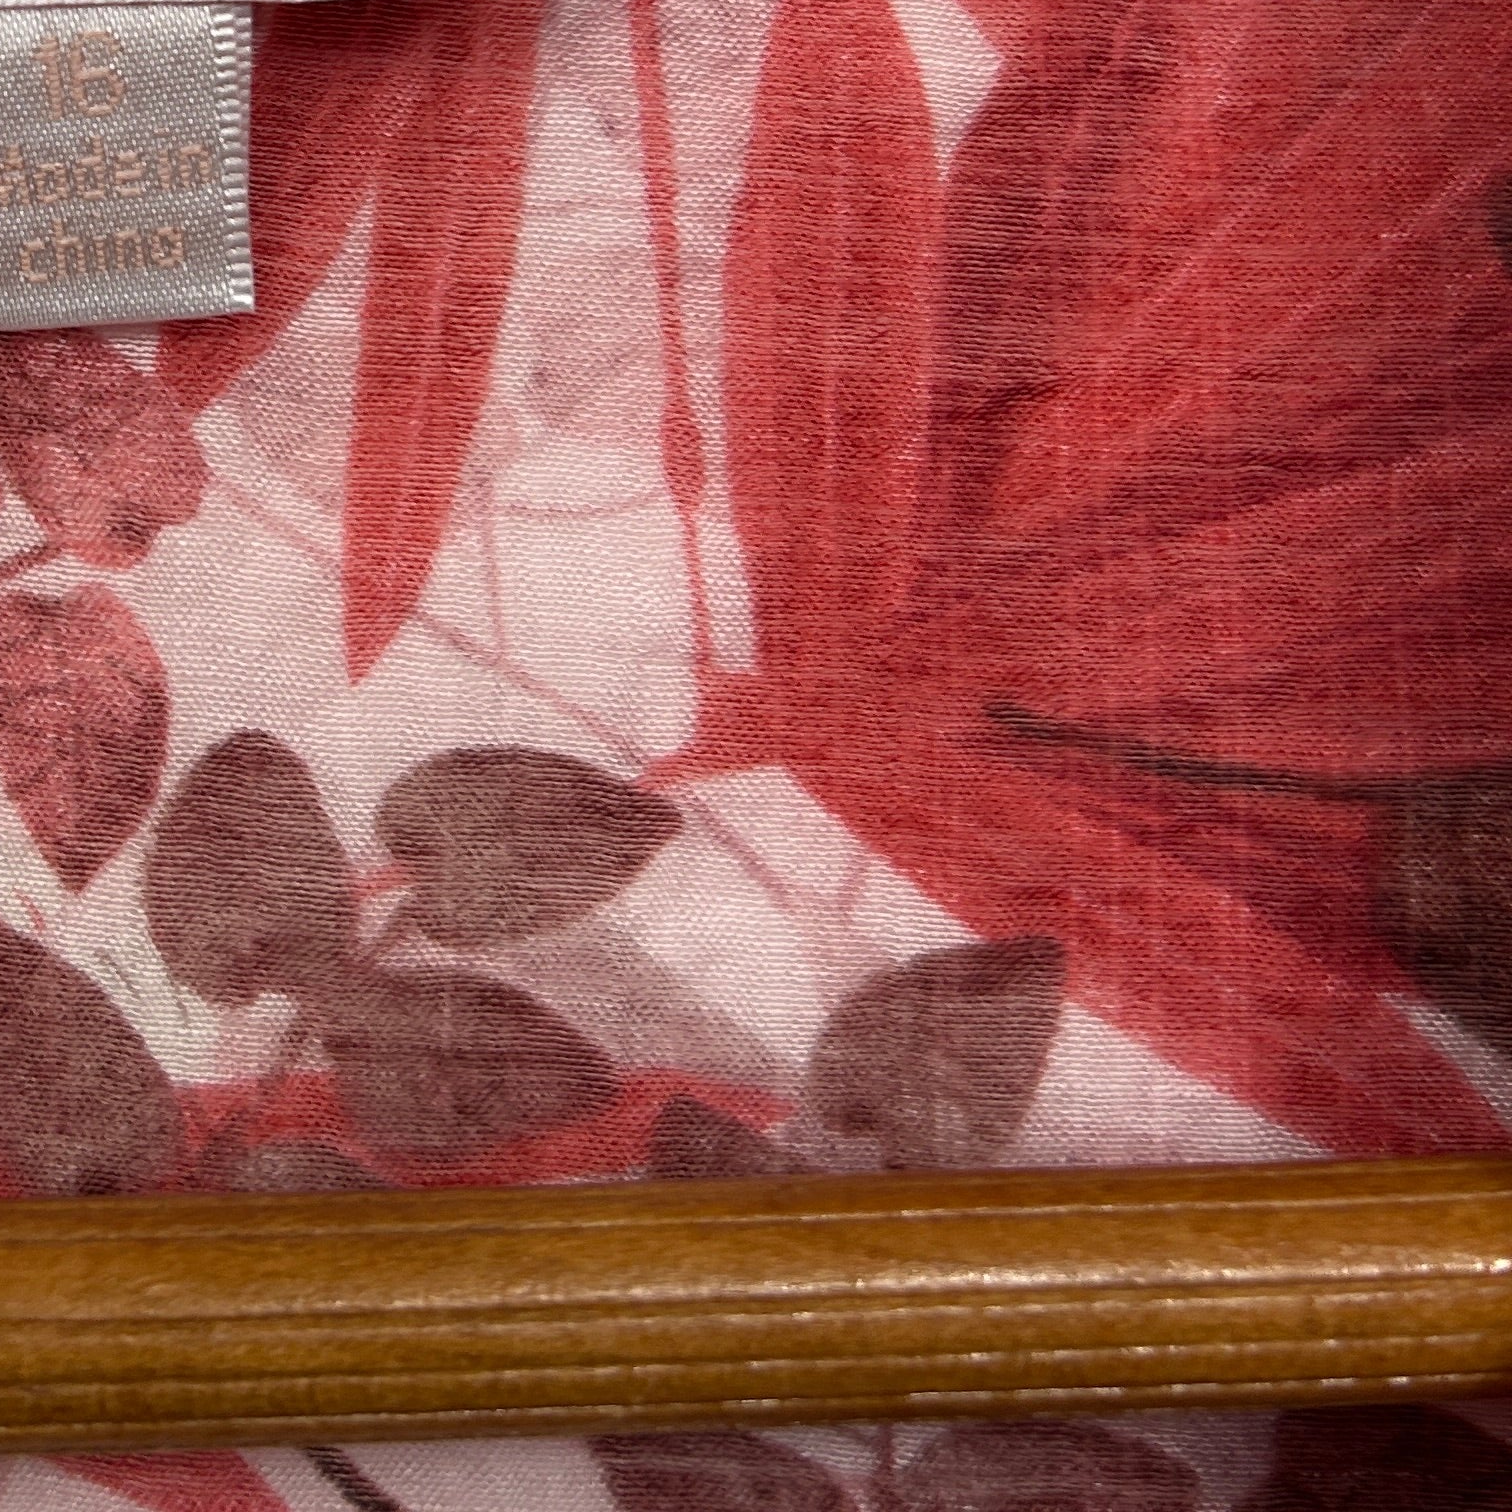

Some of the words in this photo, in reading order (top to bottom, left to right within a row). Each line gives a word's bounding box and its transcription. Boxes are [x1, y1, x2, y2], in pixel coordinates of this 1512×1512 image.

[34, 30, 126, 120] 16
[156, 128, 213, 192] in
[20, 218, 185, 285] china
